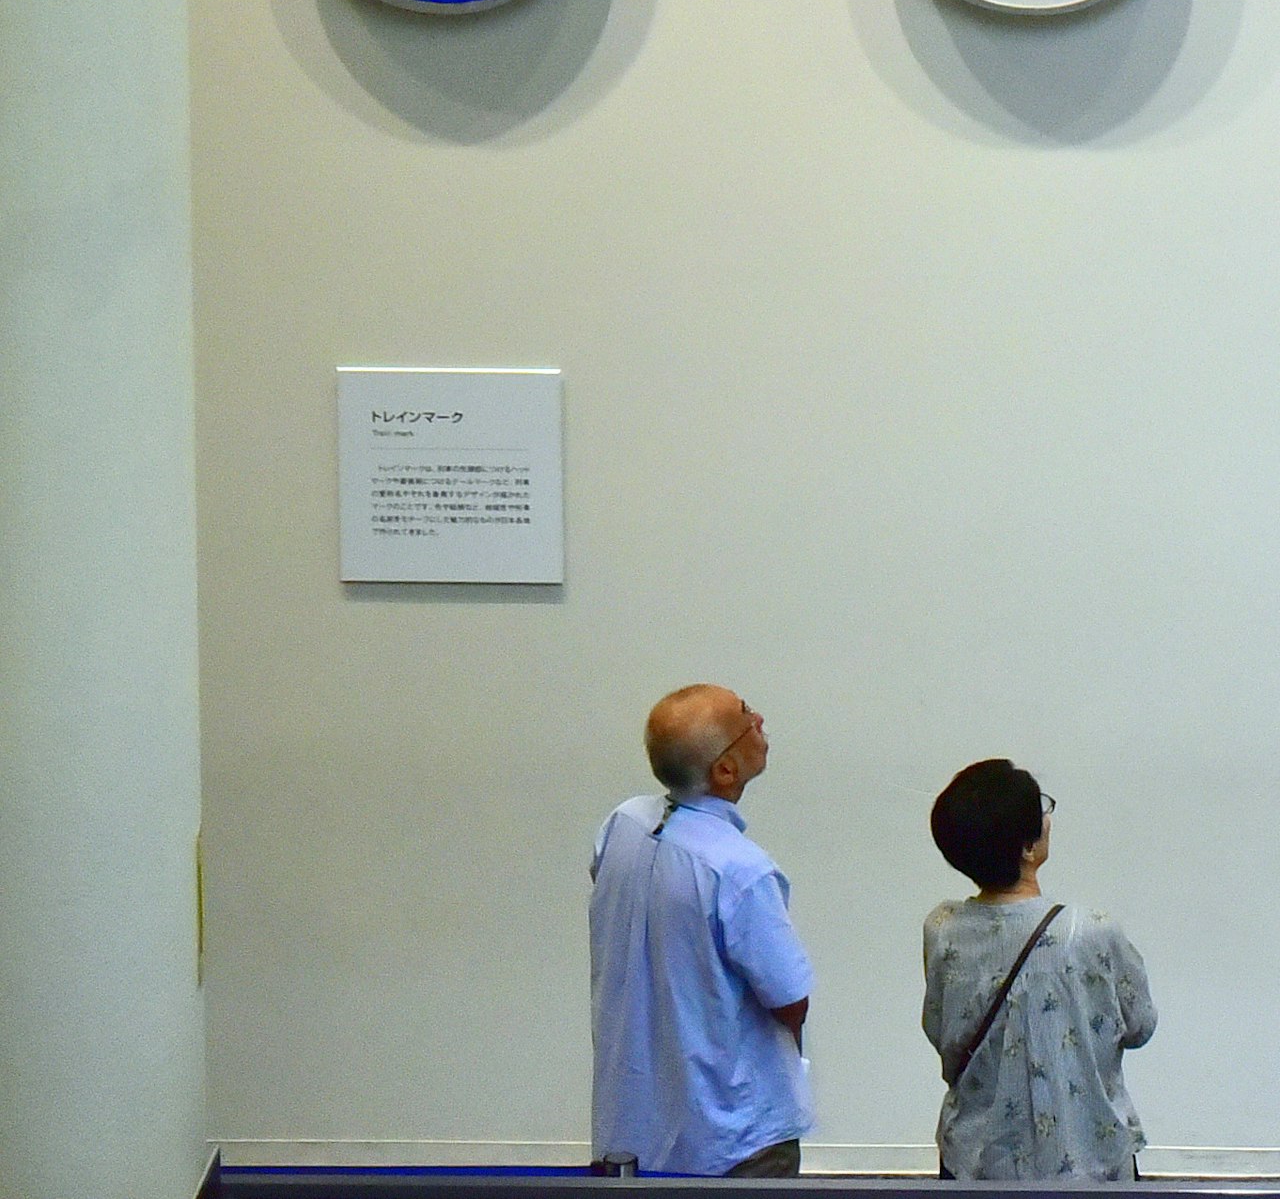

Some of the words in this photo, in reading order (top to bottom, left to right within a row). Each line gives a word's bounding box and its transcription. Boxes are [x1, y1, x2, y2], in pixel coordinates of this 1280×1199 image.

[372, 411, 464, 423] トレインマーク
